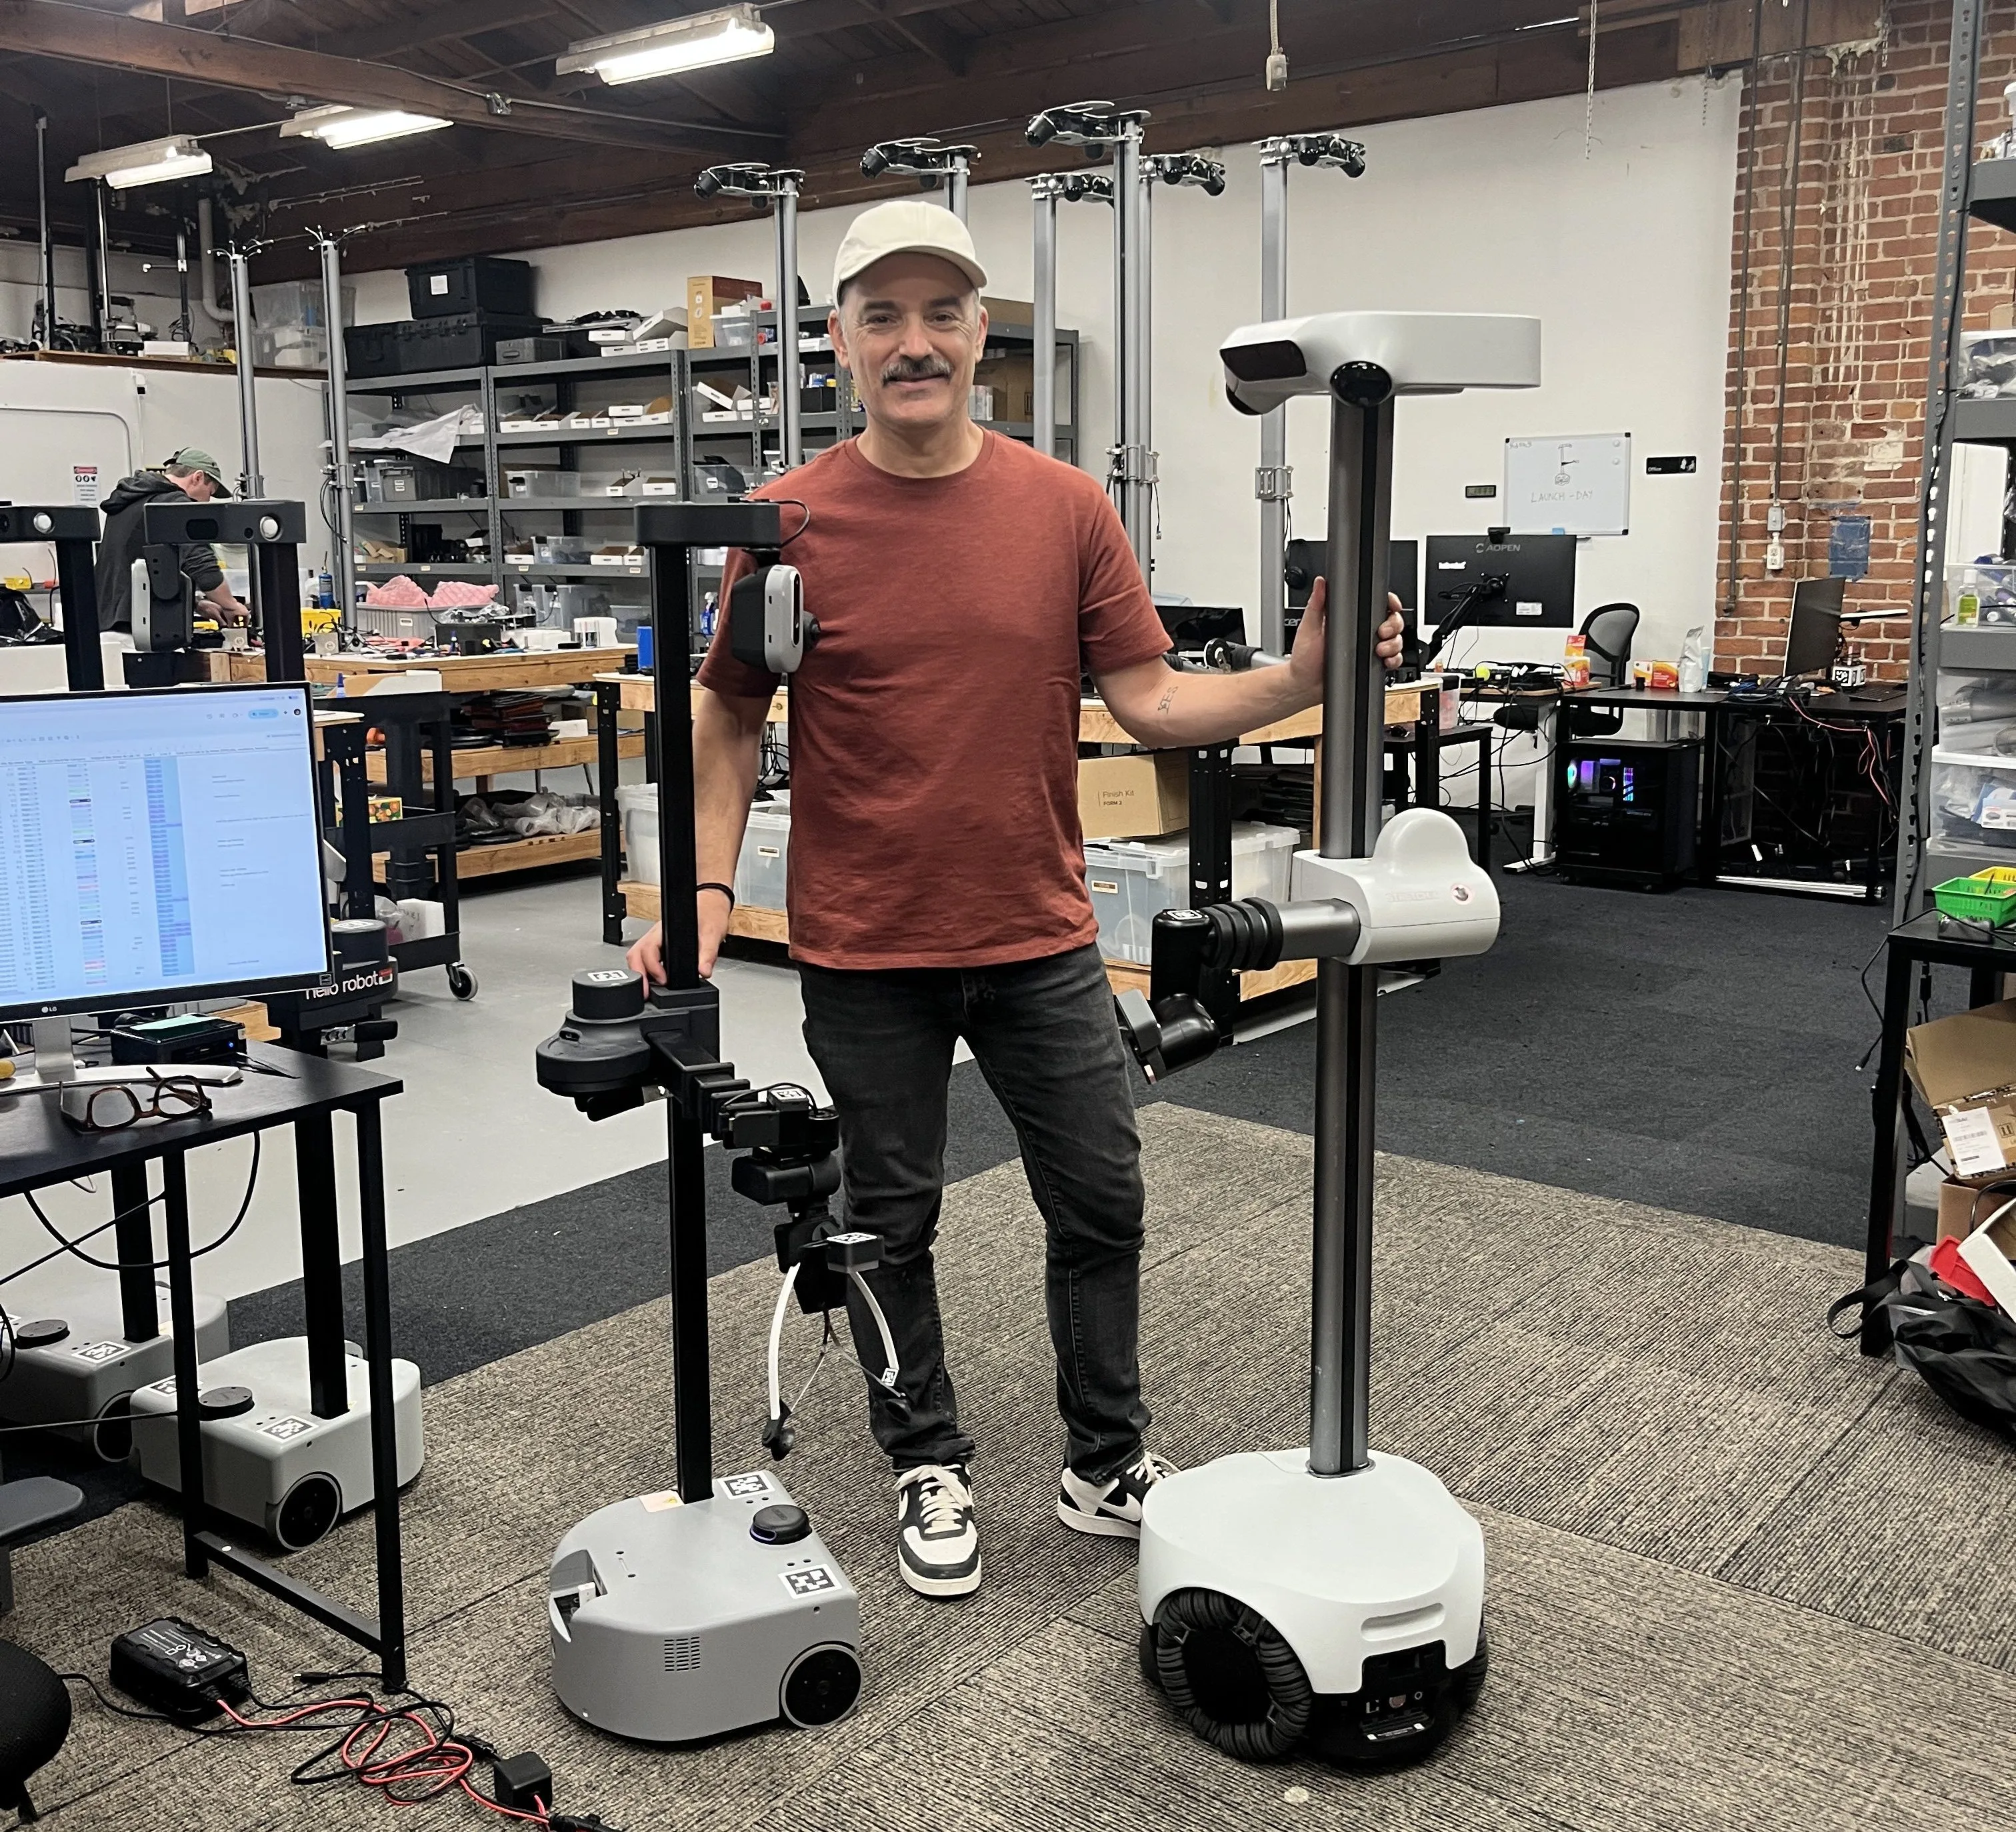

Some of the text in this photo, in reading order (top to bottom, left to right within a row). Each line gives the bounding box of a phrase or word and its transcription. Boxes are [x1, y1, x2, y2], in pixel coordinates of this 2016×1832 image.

[1531, 492, 1565, 503] LAUNCH
[1485, 544, 1521, 552] AOPEN
[343, 970, 378, 993] robot
